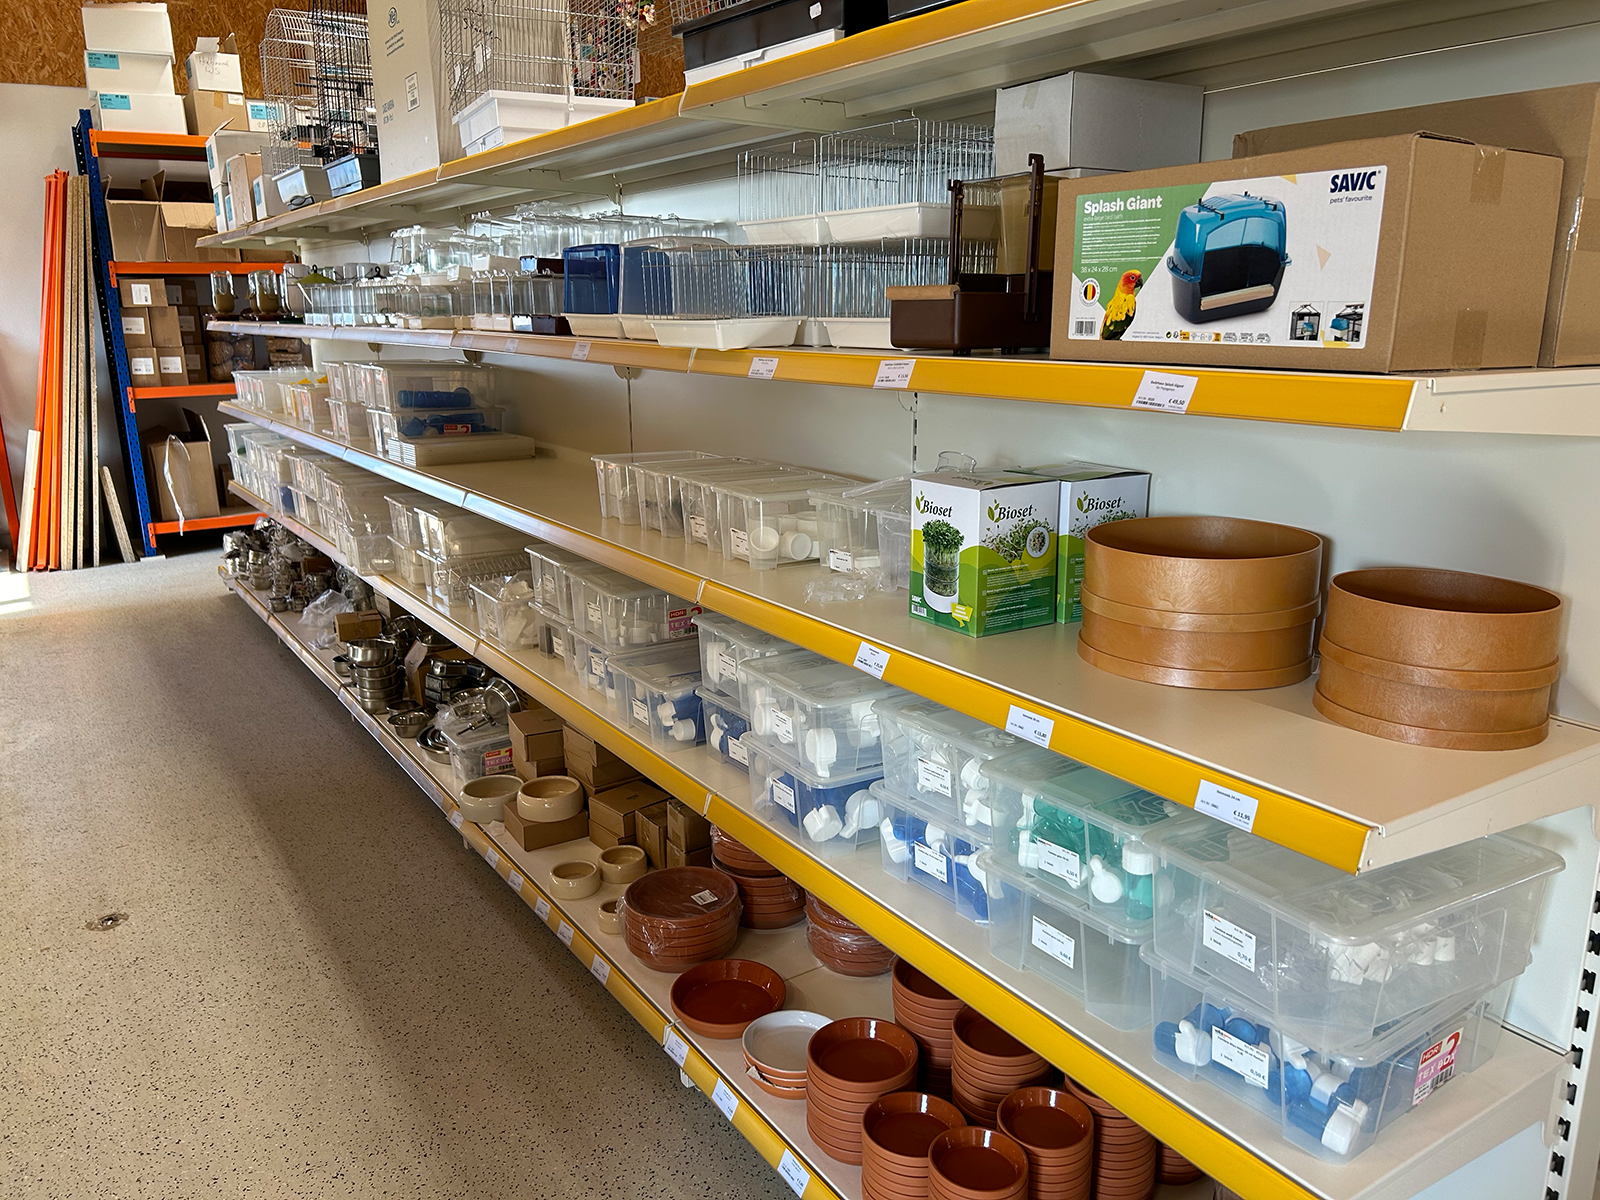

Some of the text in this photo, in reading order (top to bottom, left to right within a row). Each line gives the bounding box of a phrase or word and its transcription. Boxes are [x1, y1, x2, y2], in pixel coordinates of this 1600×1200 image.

[1330, 171, 1376, 193] SAVIC
[1084, 195, 1163, 216] Splash Giant
[1345, 195, 1373, 203] favourite
[923, 500, 953, 517] Bioset
[998, 504, 1033, 520] Bioset
[1087, 497, 1121, 511] Bioset
[1418, 1053, 1455, 1083] TEX BOX
